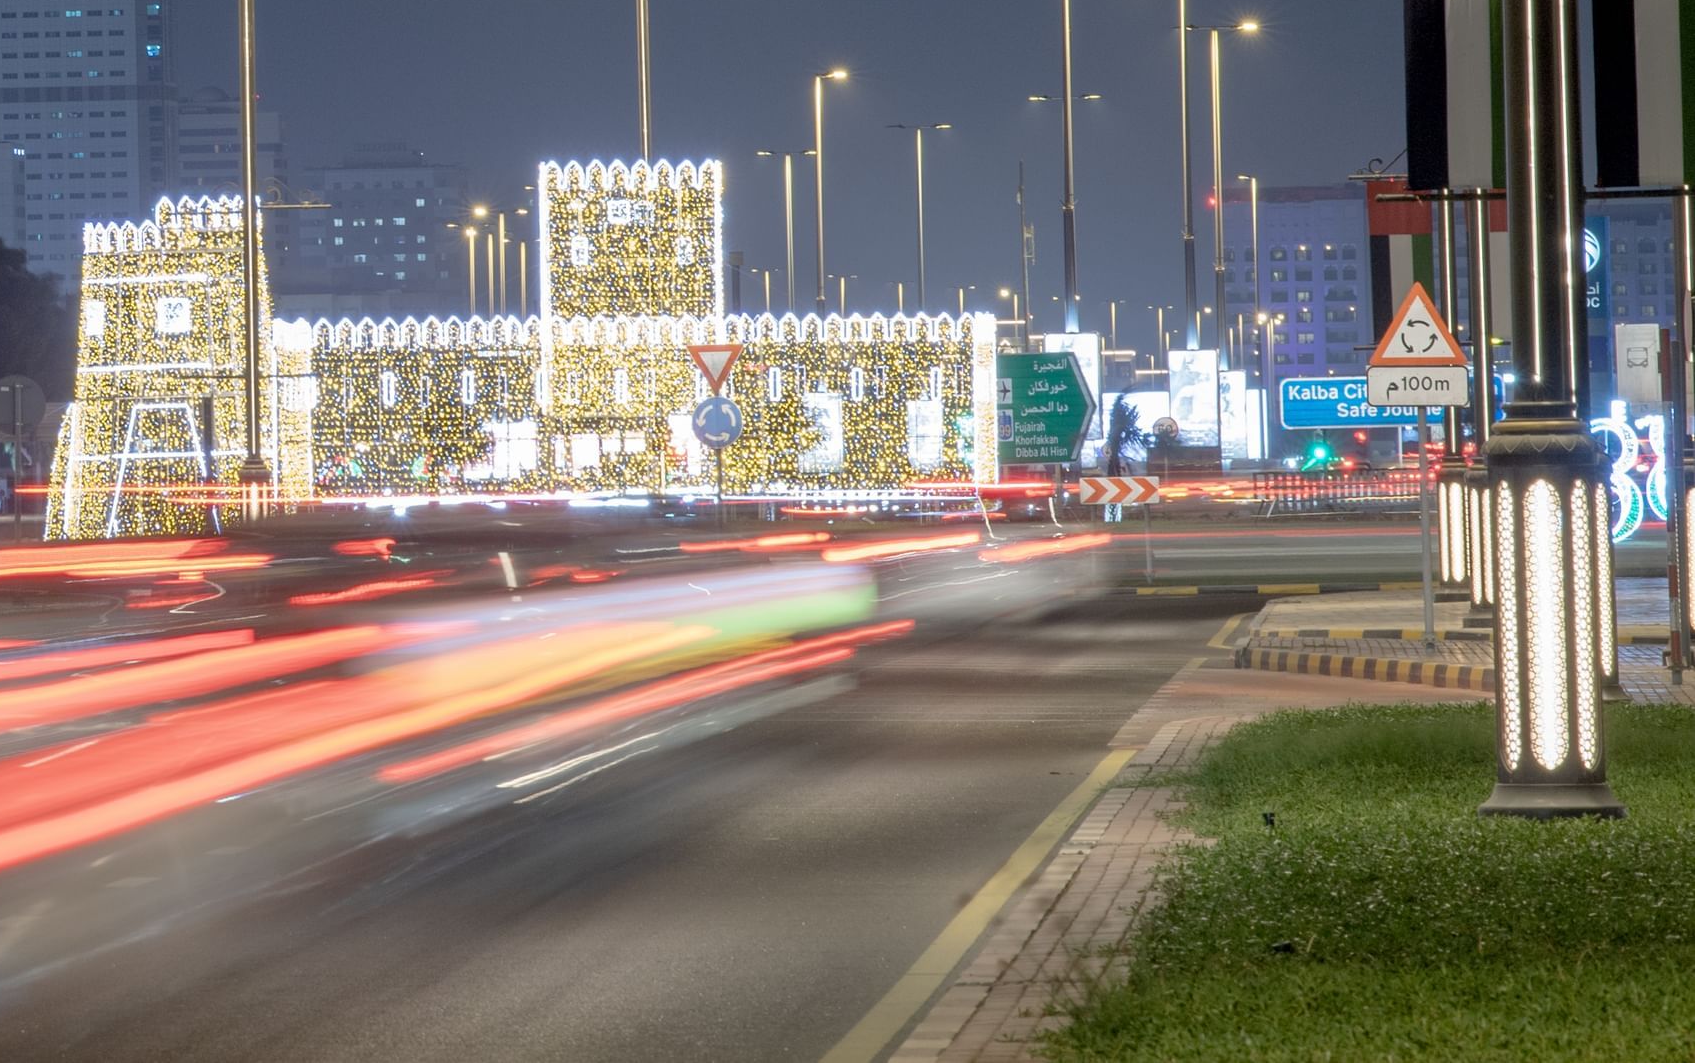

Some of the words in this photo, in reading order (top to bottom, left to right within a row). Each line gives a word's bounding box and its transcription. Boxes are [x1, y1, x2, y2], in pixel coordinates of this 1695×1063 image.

[1033, 358, 1067, 373] الفجيرة
[1288, 385, 1339, 401] Kalba
[1344, 383, 1368, 399] Cit
[1020, 401, 1054, 417] الحصن
[1337, 403, 1378, 417] Safe
[1014, 421, 1046, 434] Fujairah
[1015, 435, 1059, 445] Khorfakkan
[1015, 447, 1039, 458] Dibba
[1039, 447, 1049, 457] Al
[1050, 446, 1068, 457] Hisn
